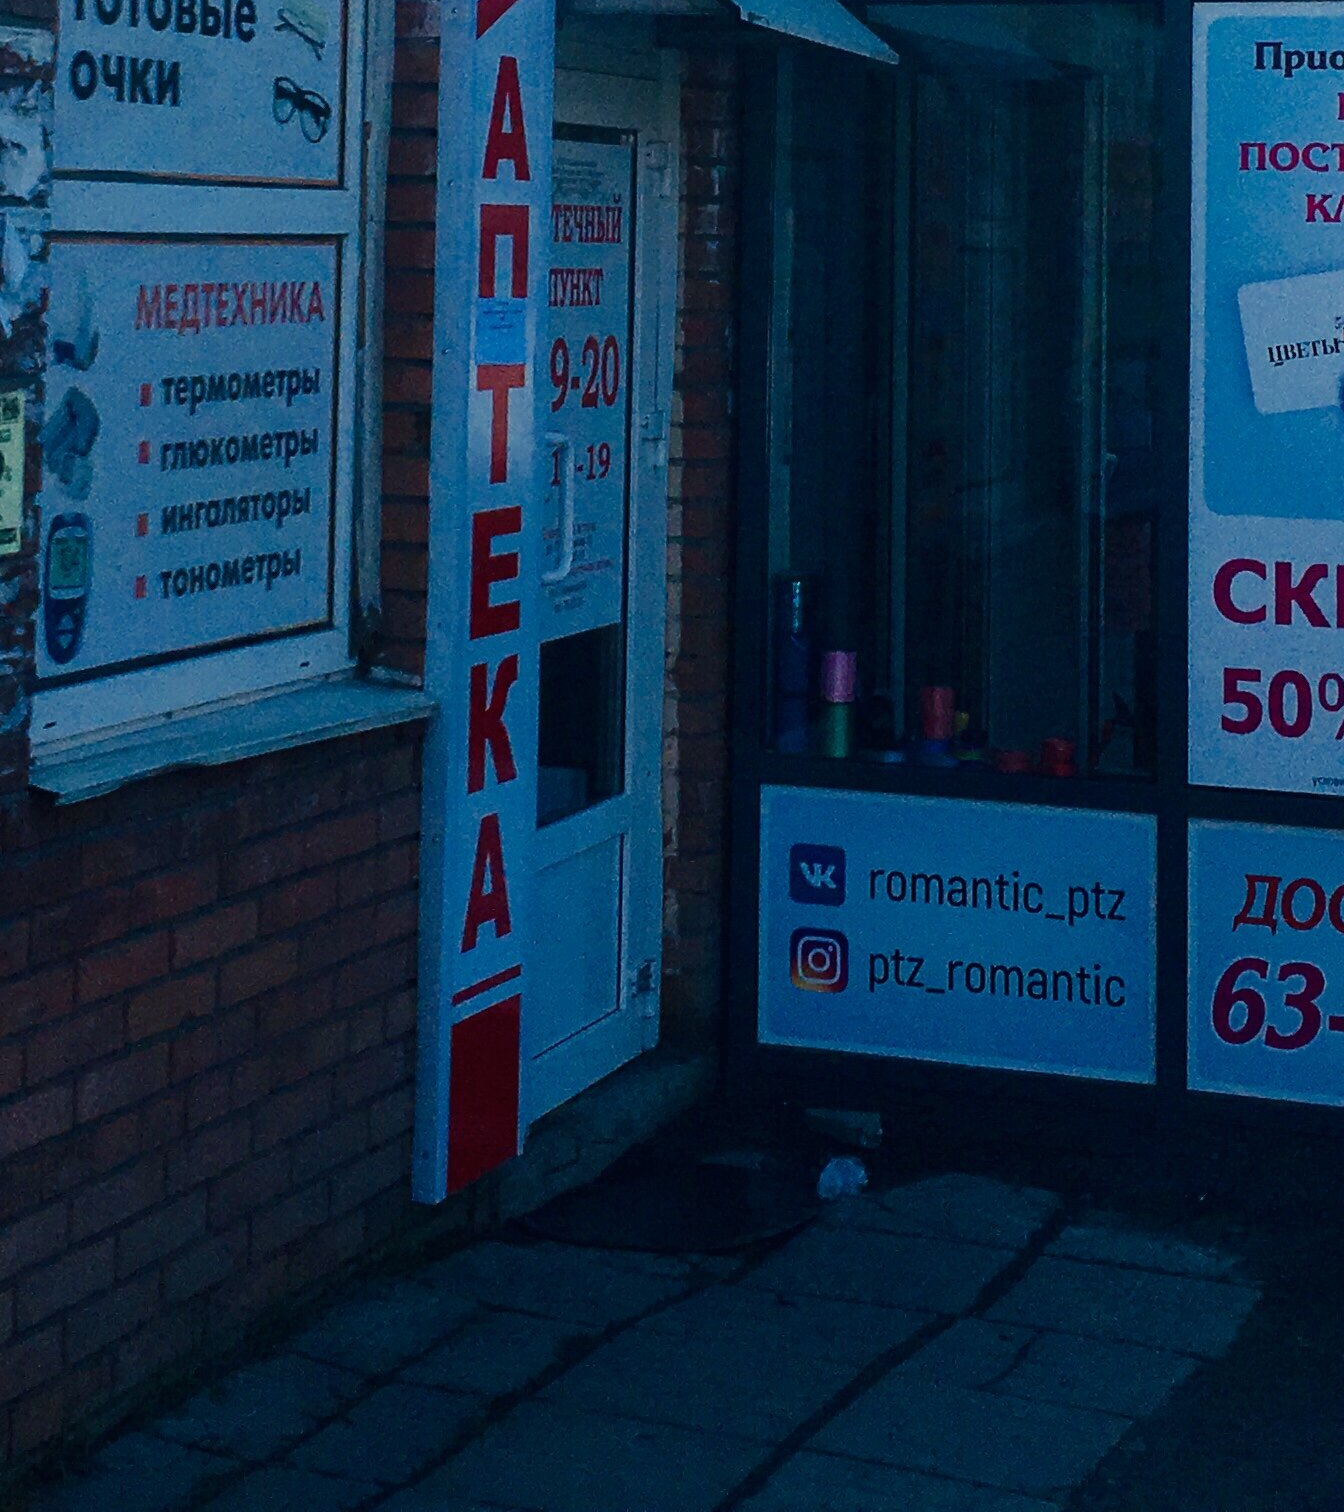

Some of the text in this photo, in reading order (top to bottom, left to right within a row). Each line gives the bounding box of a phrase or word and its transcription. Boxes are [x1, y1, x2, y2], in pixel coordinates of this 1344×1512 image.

[134, 280, 326, 336] МЕДТЕХНИКА
[160, 366, 321, 416] термометры
[159, 427, 319, 473] глюкометры
[159, 486, 312, 536] ингаляторы
[460, 54, 532, 954] АПТЕКА
[158, 547, 303, 601] тонометры
[867, 863, 1127, 928] romantic_ptz
[867, 947, 1127, 1009] ptz_romantic
